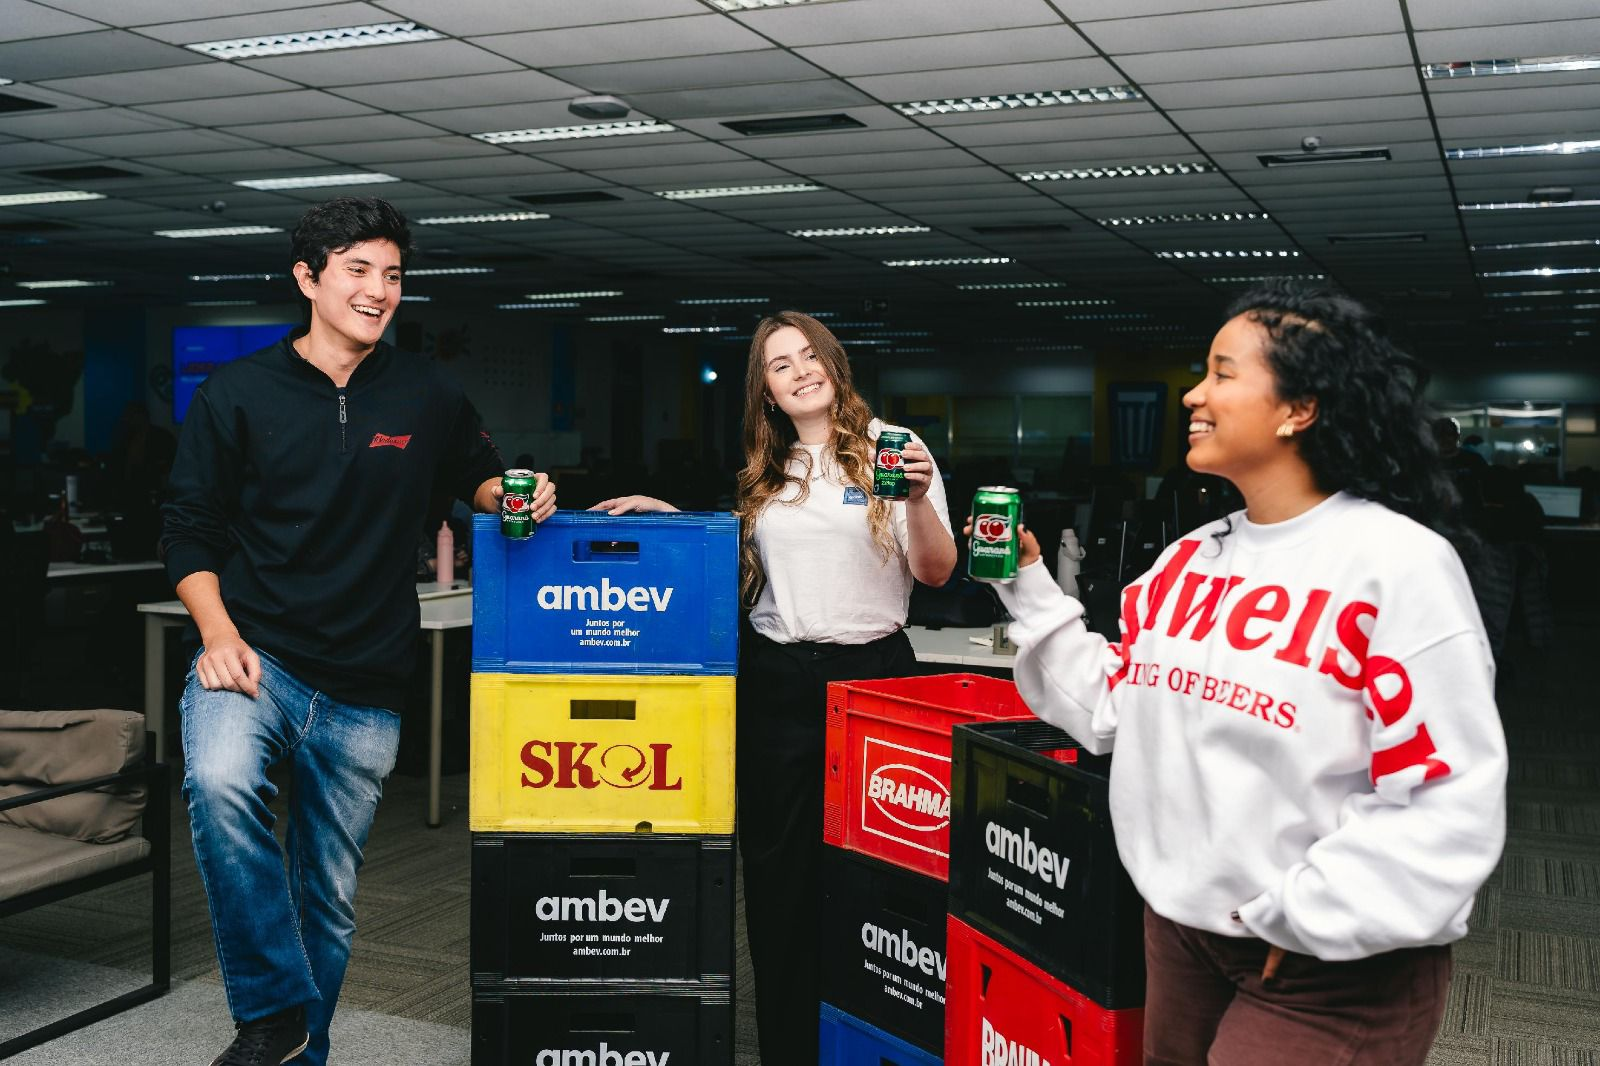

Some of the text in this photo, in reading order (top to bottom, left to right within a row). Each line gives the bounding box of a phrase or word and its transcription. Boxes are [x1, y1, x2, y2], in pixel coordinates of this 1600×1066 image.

[537, 578, 673, 612] ambev
[585, 627, 612, 636] mundo
[613, 628, 640, 637] melhor
[586, 618, 625, 629] Juntos por
[579, 637, 631, 647] ambev.com.br
[1168, 668, 1199, 696] OF
[520, 740, 682, 790] SKOL
[985, 821, 1070, 890] ambev
[535, 889, 670, 923] ambev
[988, 867, 1004, 886] Juntos
[1025, 888, 1043, 907] mundo
[1044, 899, 1065, 918] melhor
[1006, 898, 1042, 925] ambev.com.br
[539, 932, 663, 943] Juntos por um mundo melhor
[573, 947, 631, 956] ambev.com.br
[861, 922, 947, 982] ambev
[864, 959, 882, 975] Juntos
[903, 979, 923, 994] mundo
[884, 985, 923, 1010] ambev.com.br
[535, 1042, 670, 1066] ambev
